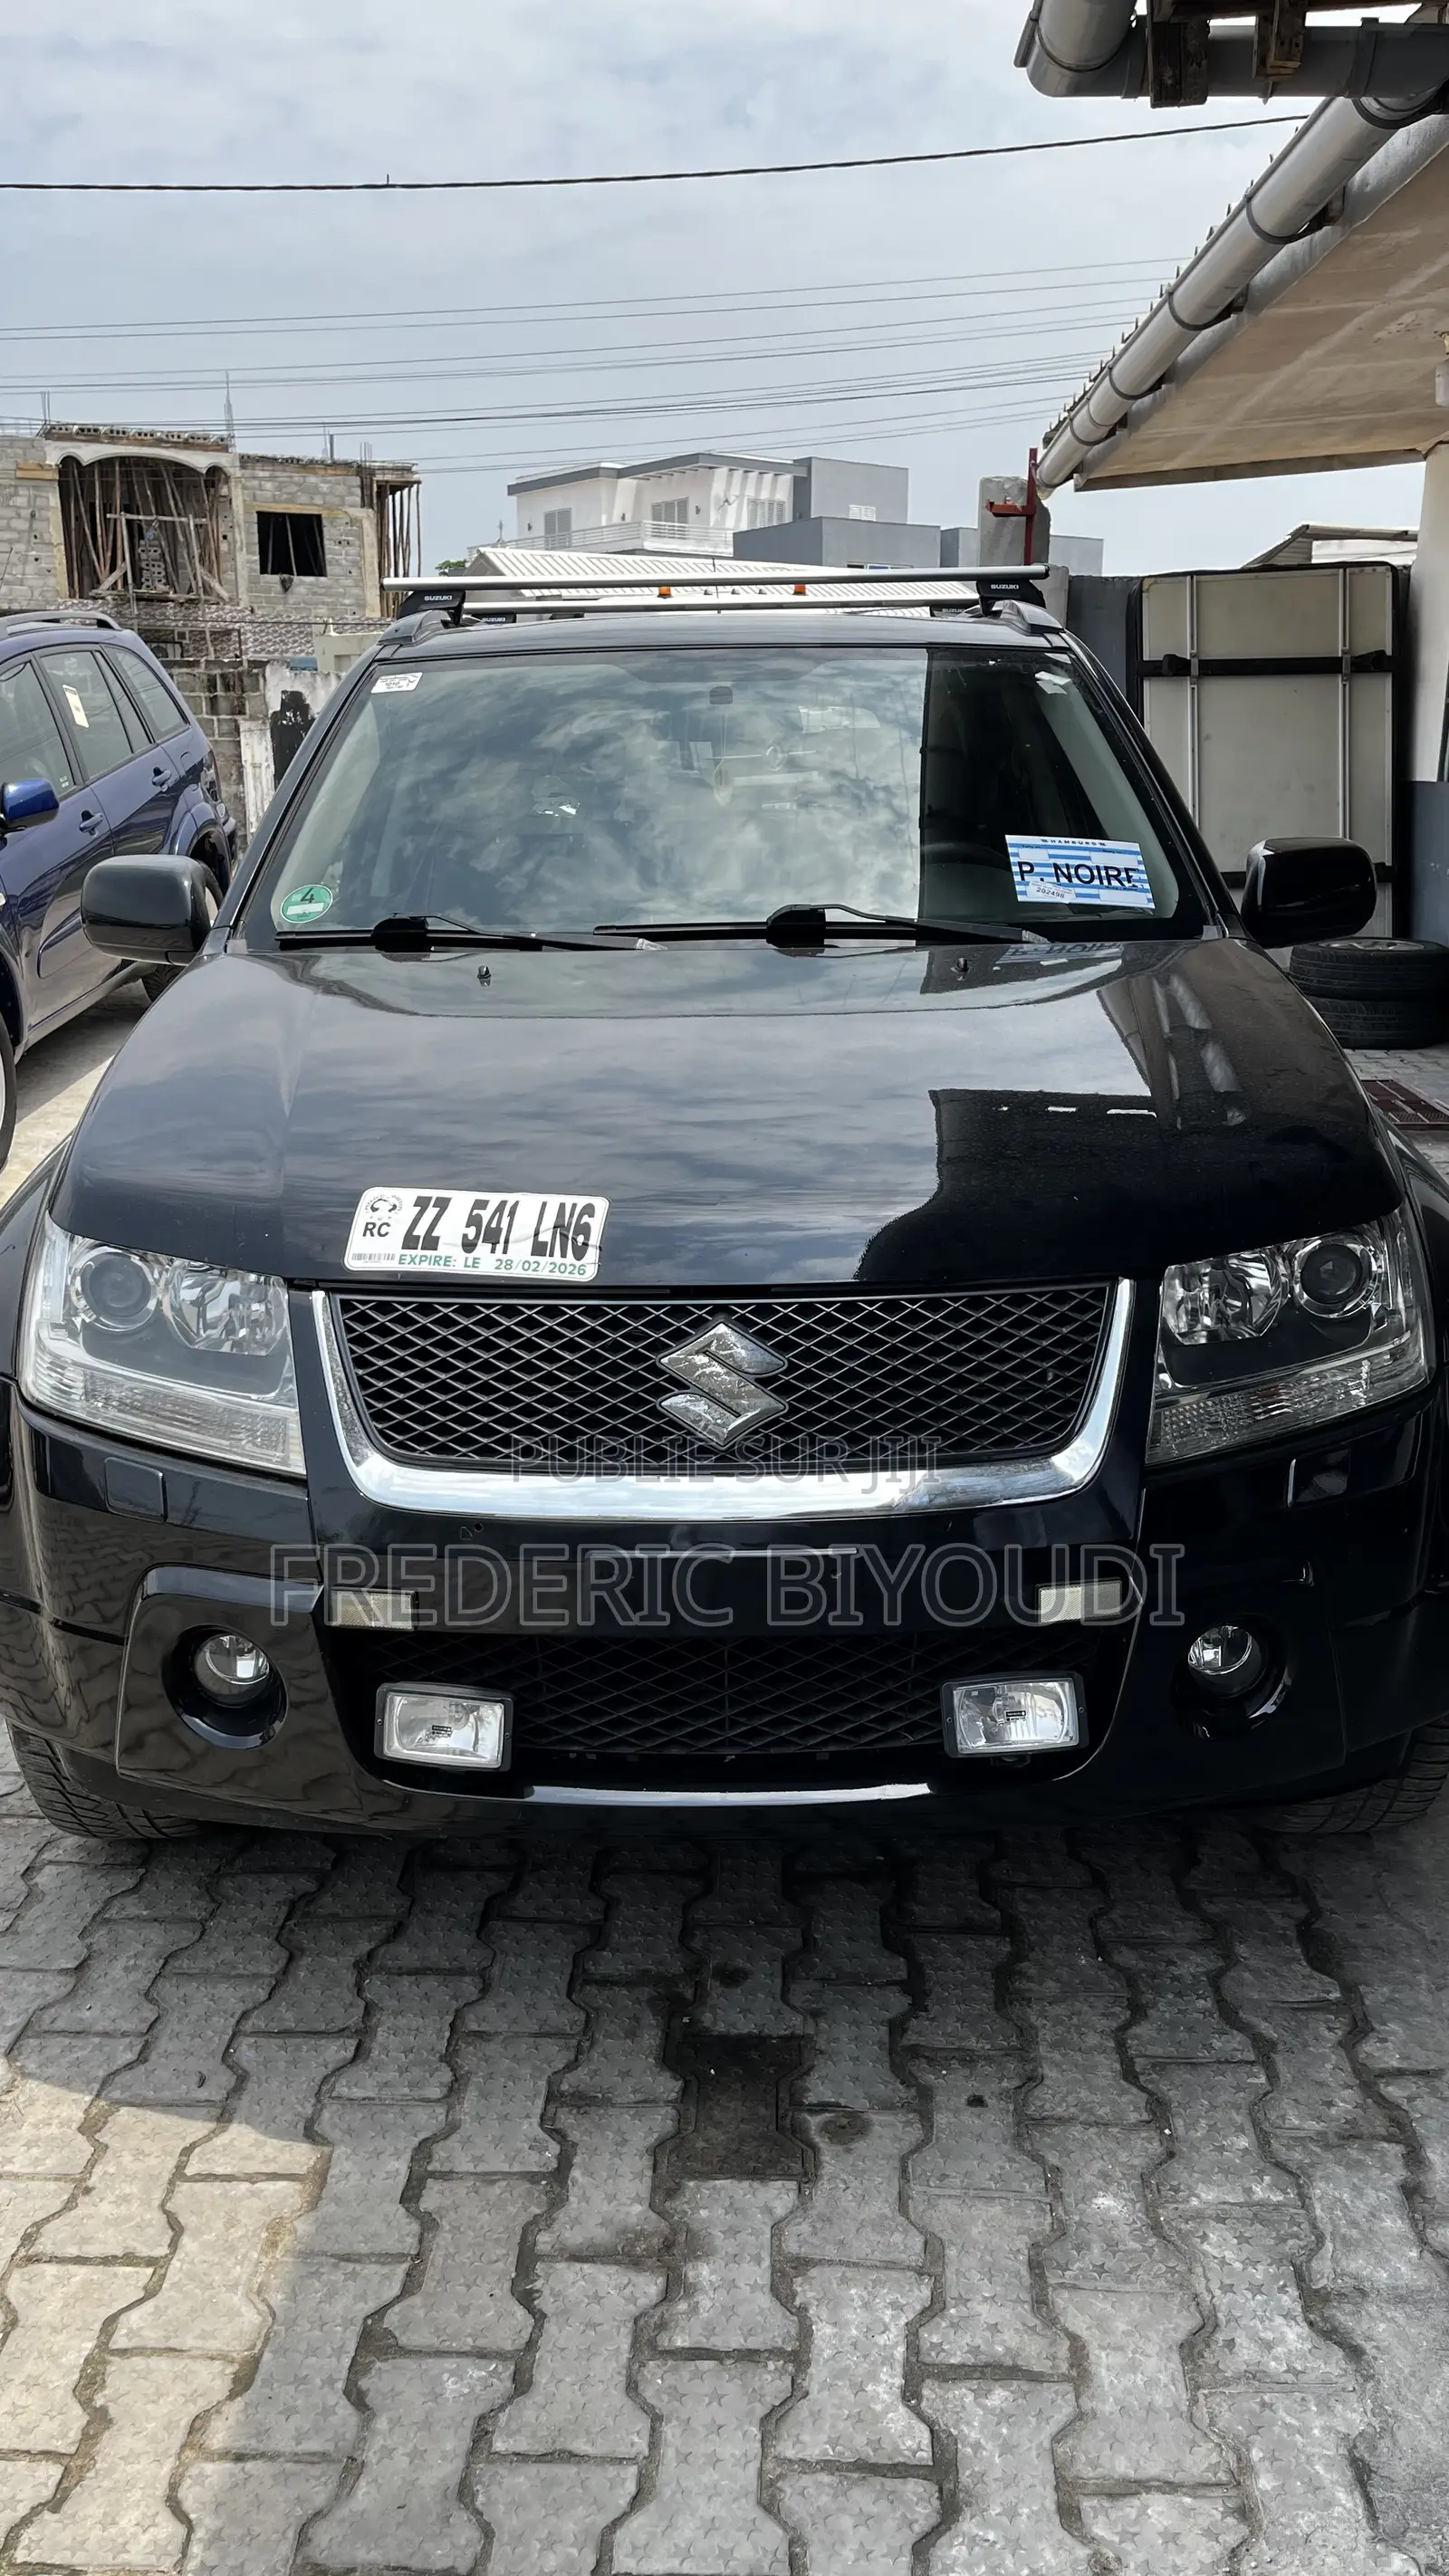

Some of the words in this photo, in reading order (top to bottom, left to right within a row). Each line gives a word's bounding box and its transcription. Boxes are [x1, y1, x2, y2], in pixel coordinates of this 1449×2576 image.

[301, 887, 315, 904] 4
[1037, 886, 1065, 898] 202498
[362, 1221, 391, 1238] RC
[401, 1196, 453, 1251] ZZ
[461, 1199, 520, 1254] 541
[531, 1201, 596, 1261] LN6
[398, 1253, 456, 1268] EXPIRE:
[464, 1257, 481, 1269] LE
[494, 1259, 587, 1276] 28/02/2026
